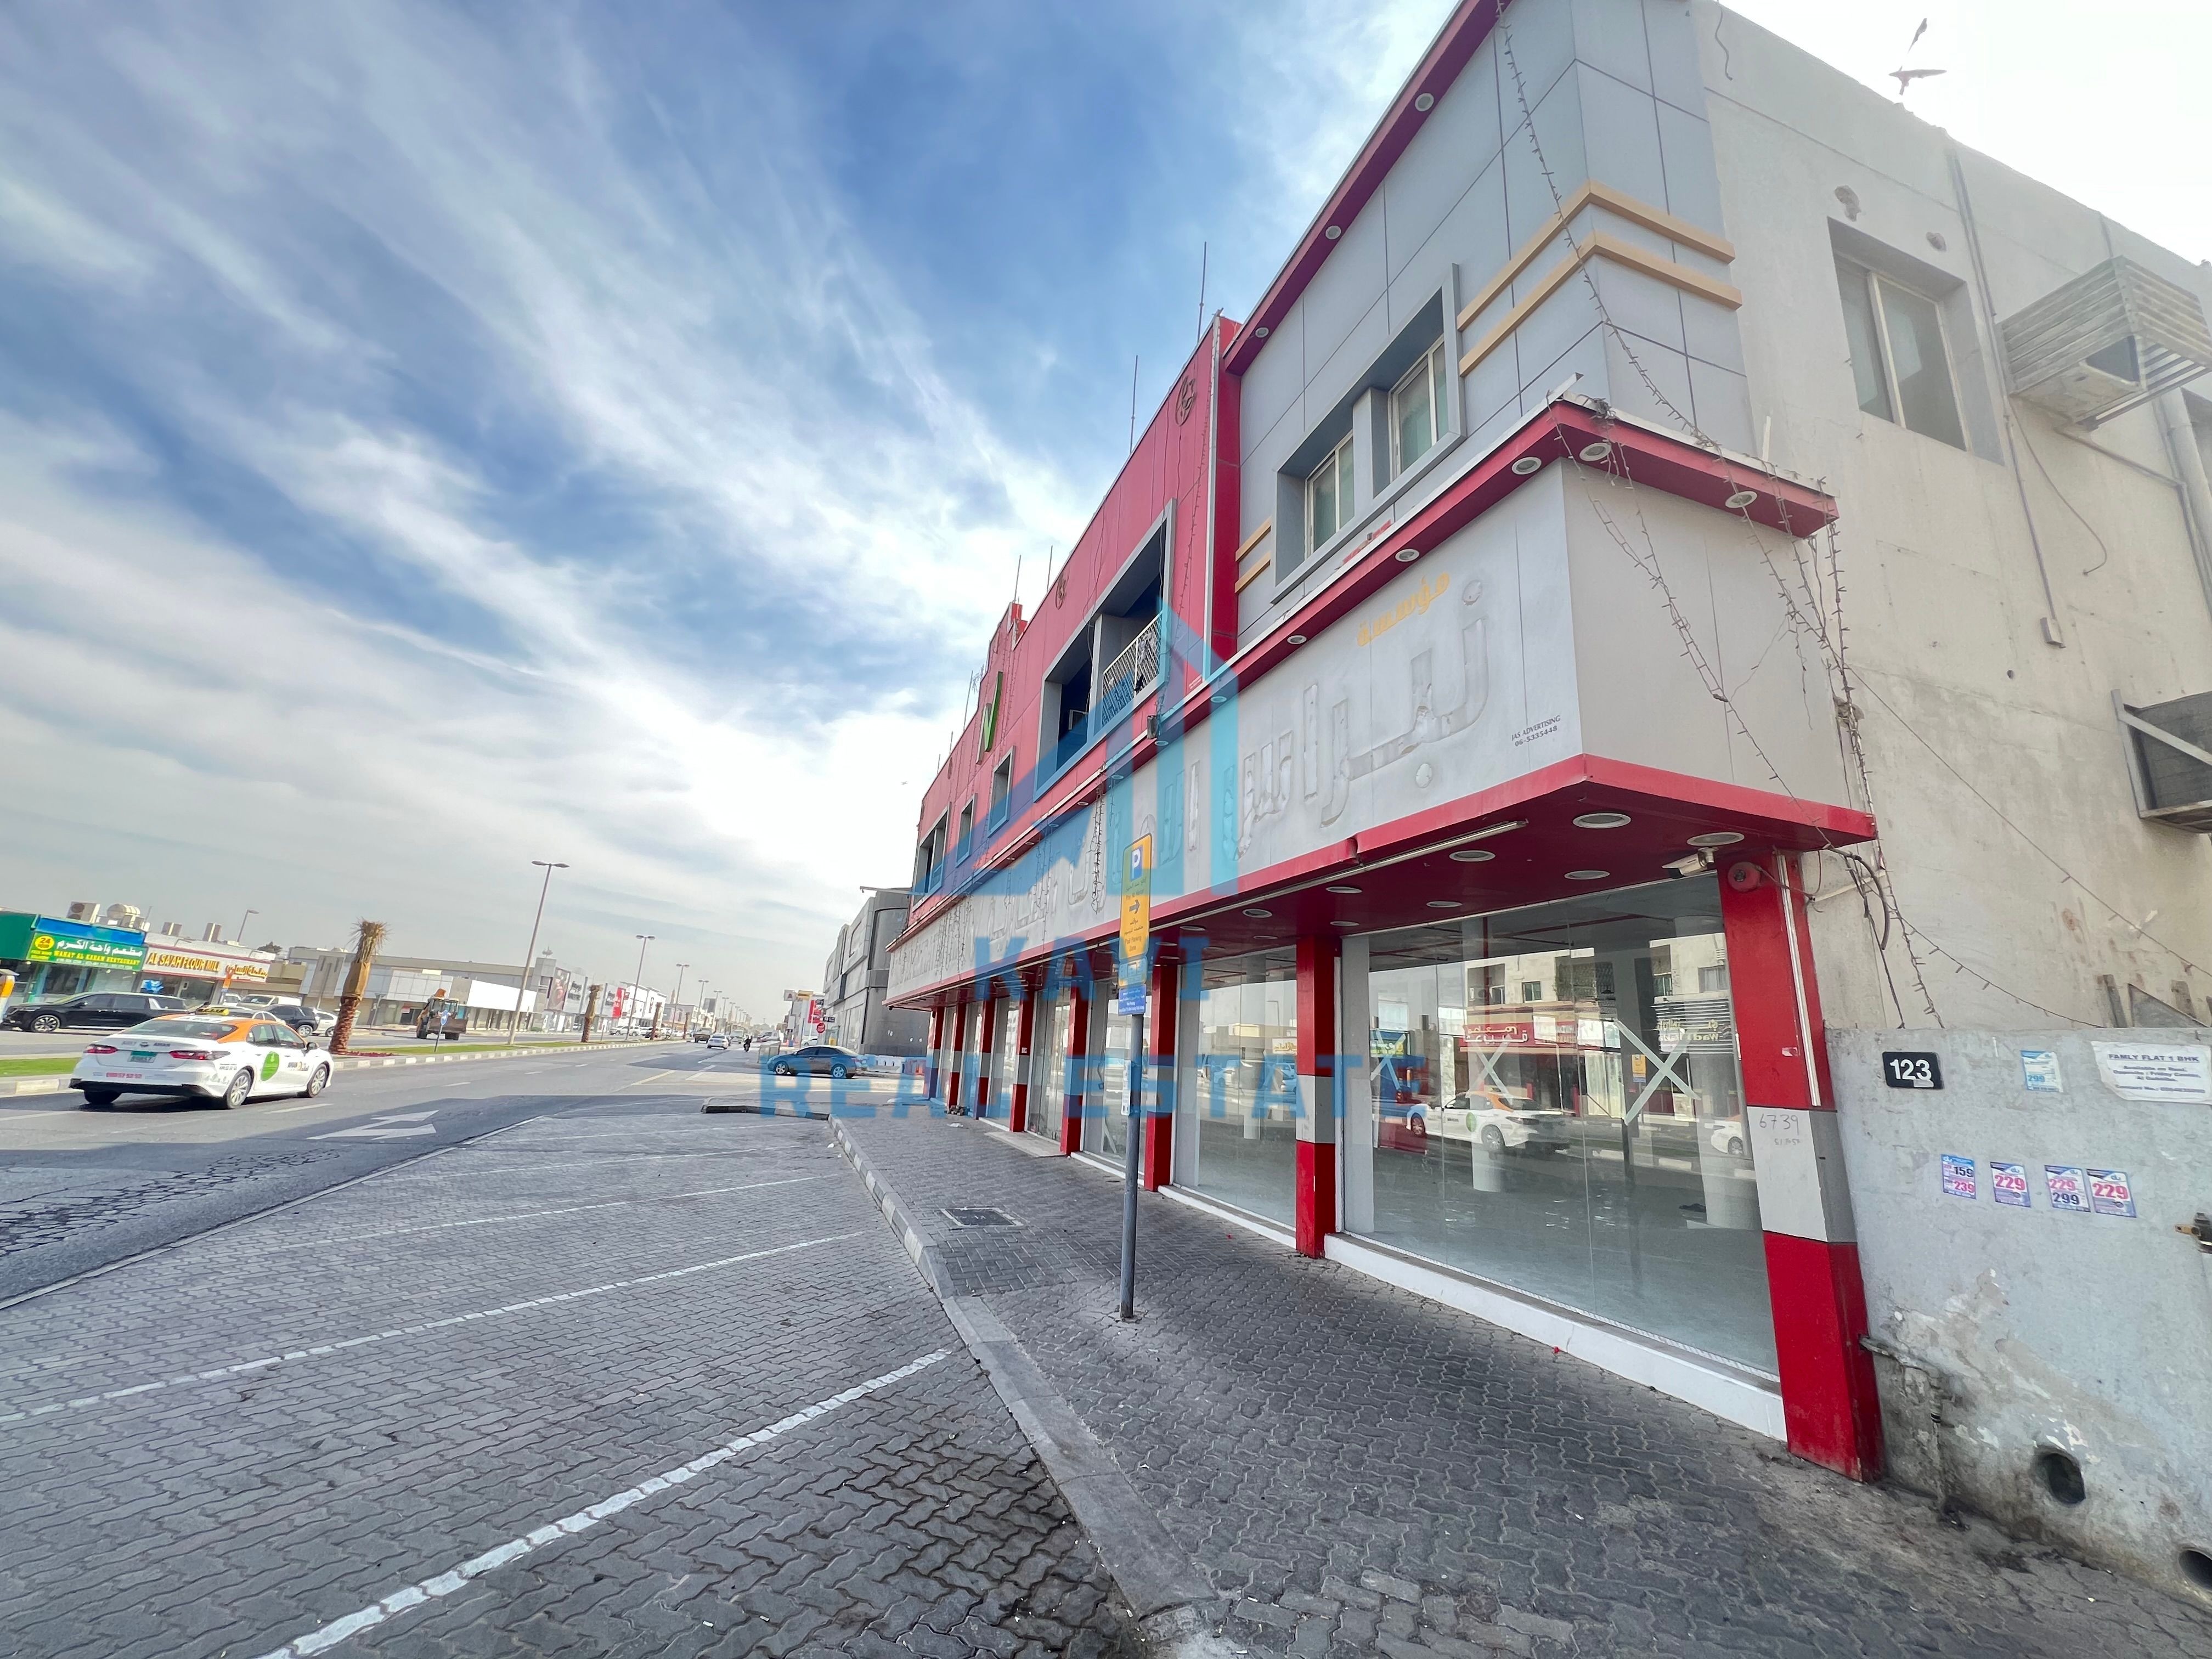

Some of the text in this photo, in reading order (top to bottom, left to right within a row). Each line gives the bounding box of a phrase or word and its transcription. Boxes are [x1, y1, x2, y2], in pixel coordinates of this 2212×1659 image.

[1357, 573, 1450, 647] مؤسسة
[1522, 715, 1561, 736] ADVERTISING
[1131, 849, 1141, 879] P
[57, 939, 143, 958] مطعم واحة الكرم
[147, 952, 159, 965] AL
[183, 956, 206, 970] FLOUR
[1889, 1059, 1932, 1081] 123
[1954, 1166, 1974, 1177] 159
[1954, 1181, 1975, 1193] 239
[1994, 1174, 2025, 1191] 229
[2049, 1178, 2076, 1191] 229
[2052, 1192, 2080, 1205] 299
[2092, 1183, 2129, 1200] 229
